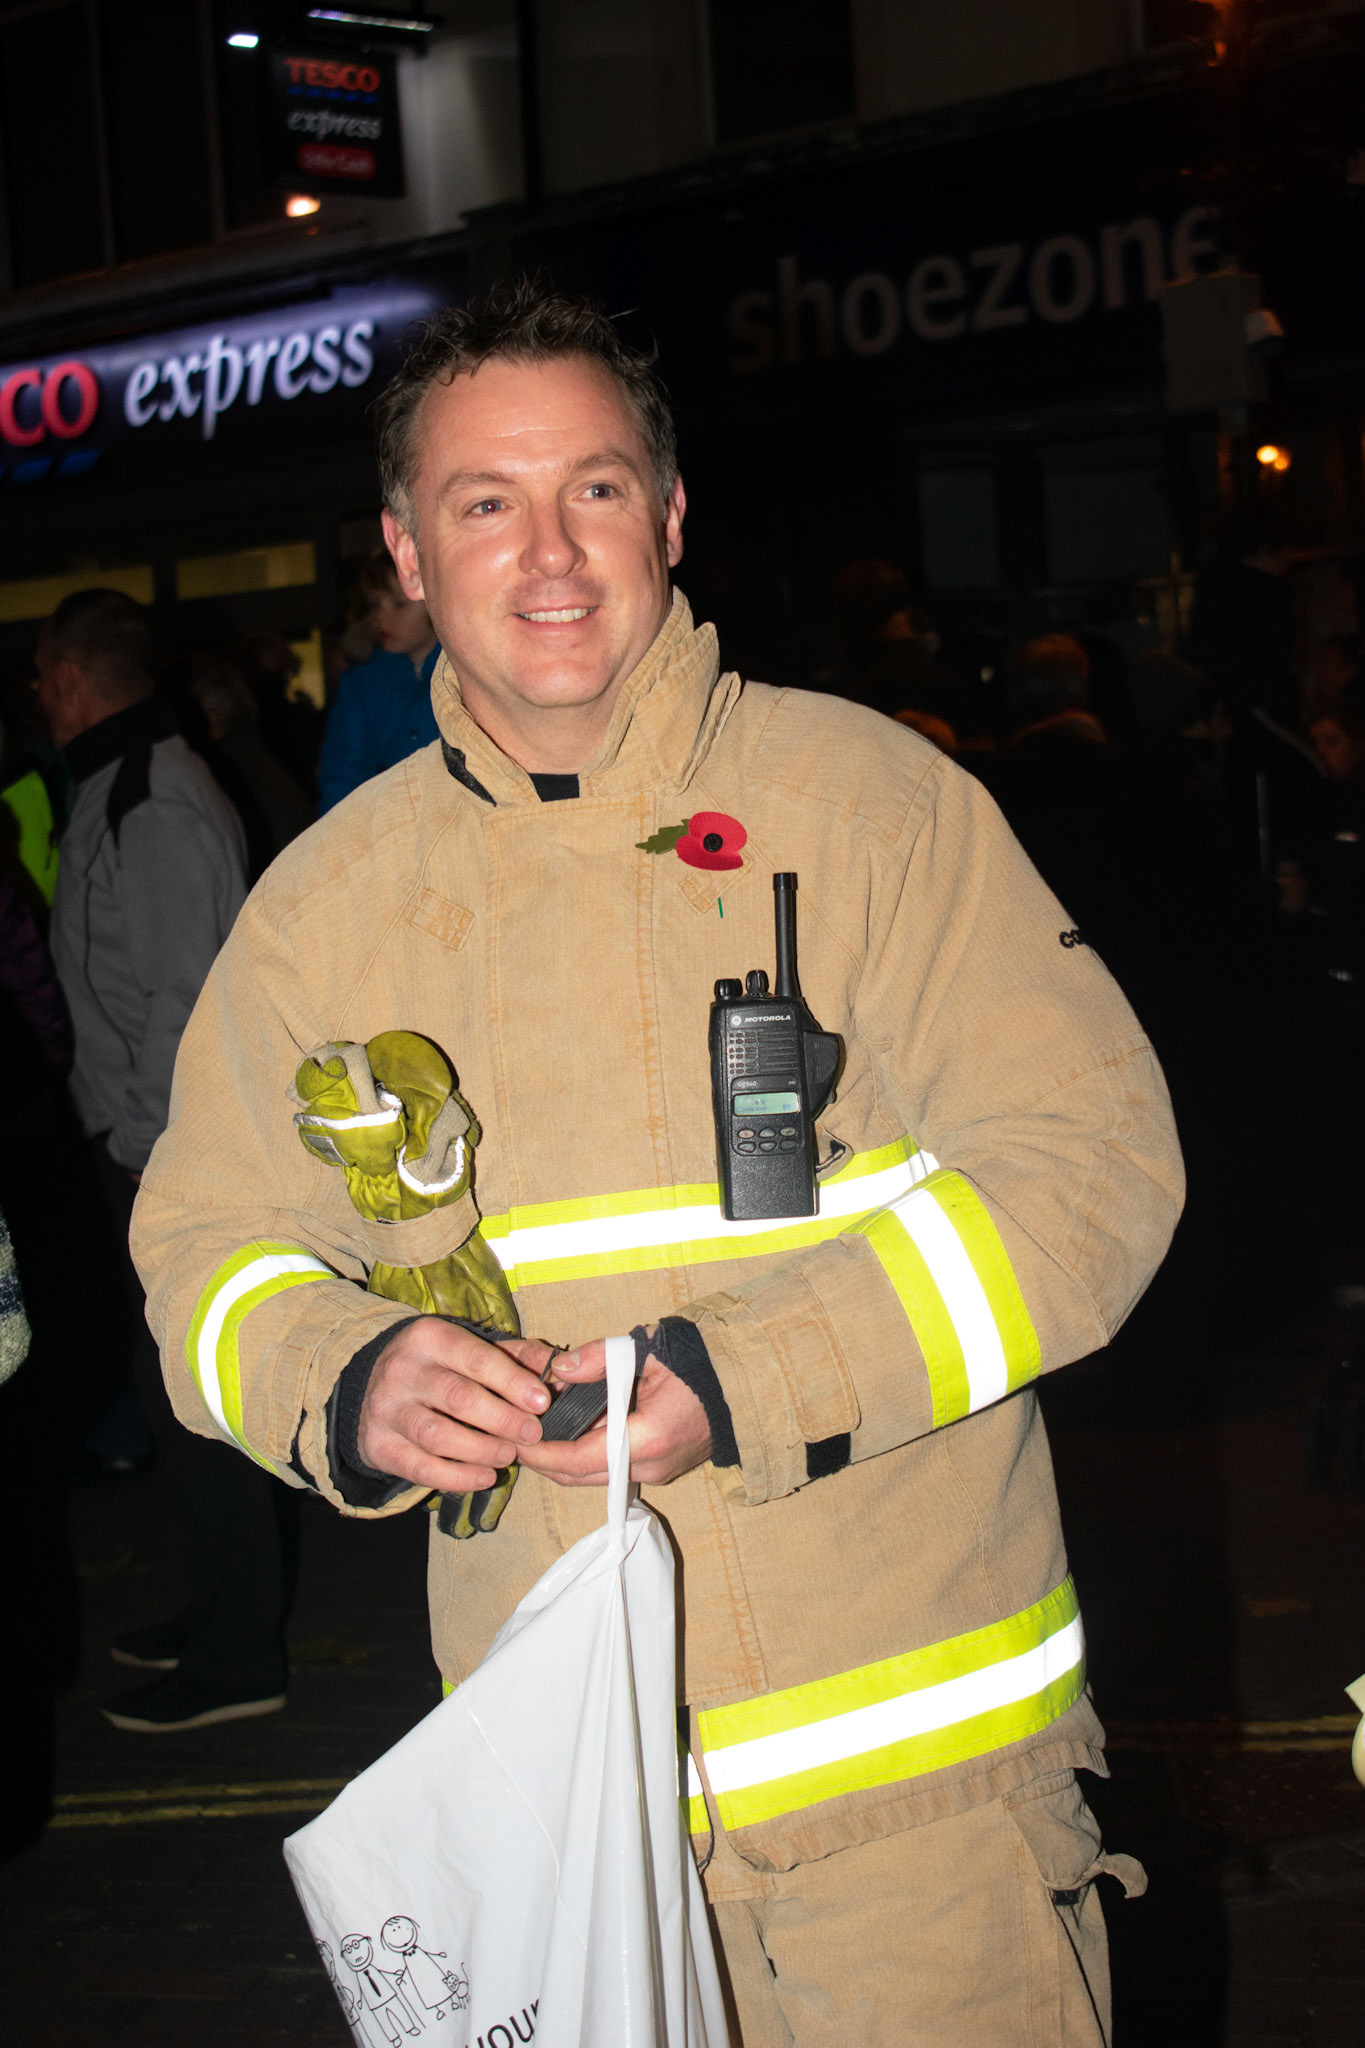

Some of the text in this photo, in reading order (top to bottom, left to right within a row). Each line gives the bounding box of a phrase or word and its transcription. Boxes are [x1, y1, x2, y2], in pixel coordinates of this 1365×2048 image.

[283, 57, 381, 92] TESCO
[286, 108, 383, 140] express
[725, 204, 1223, 376] shoezone
[124, 320, 374, 440] express
[744, 1015, 791, 1023] MOTOROLA
